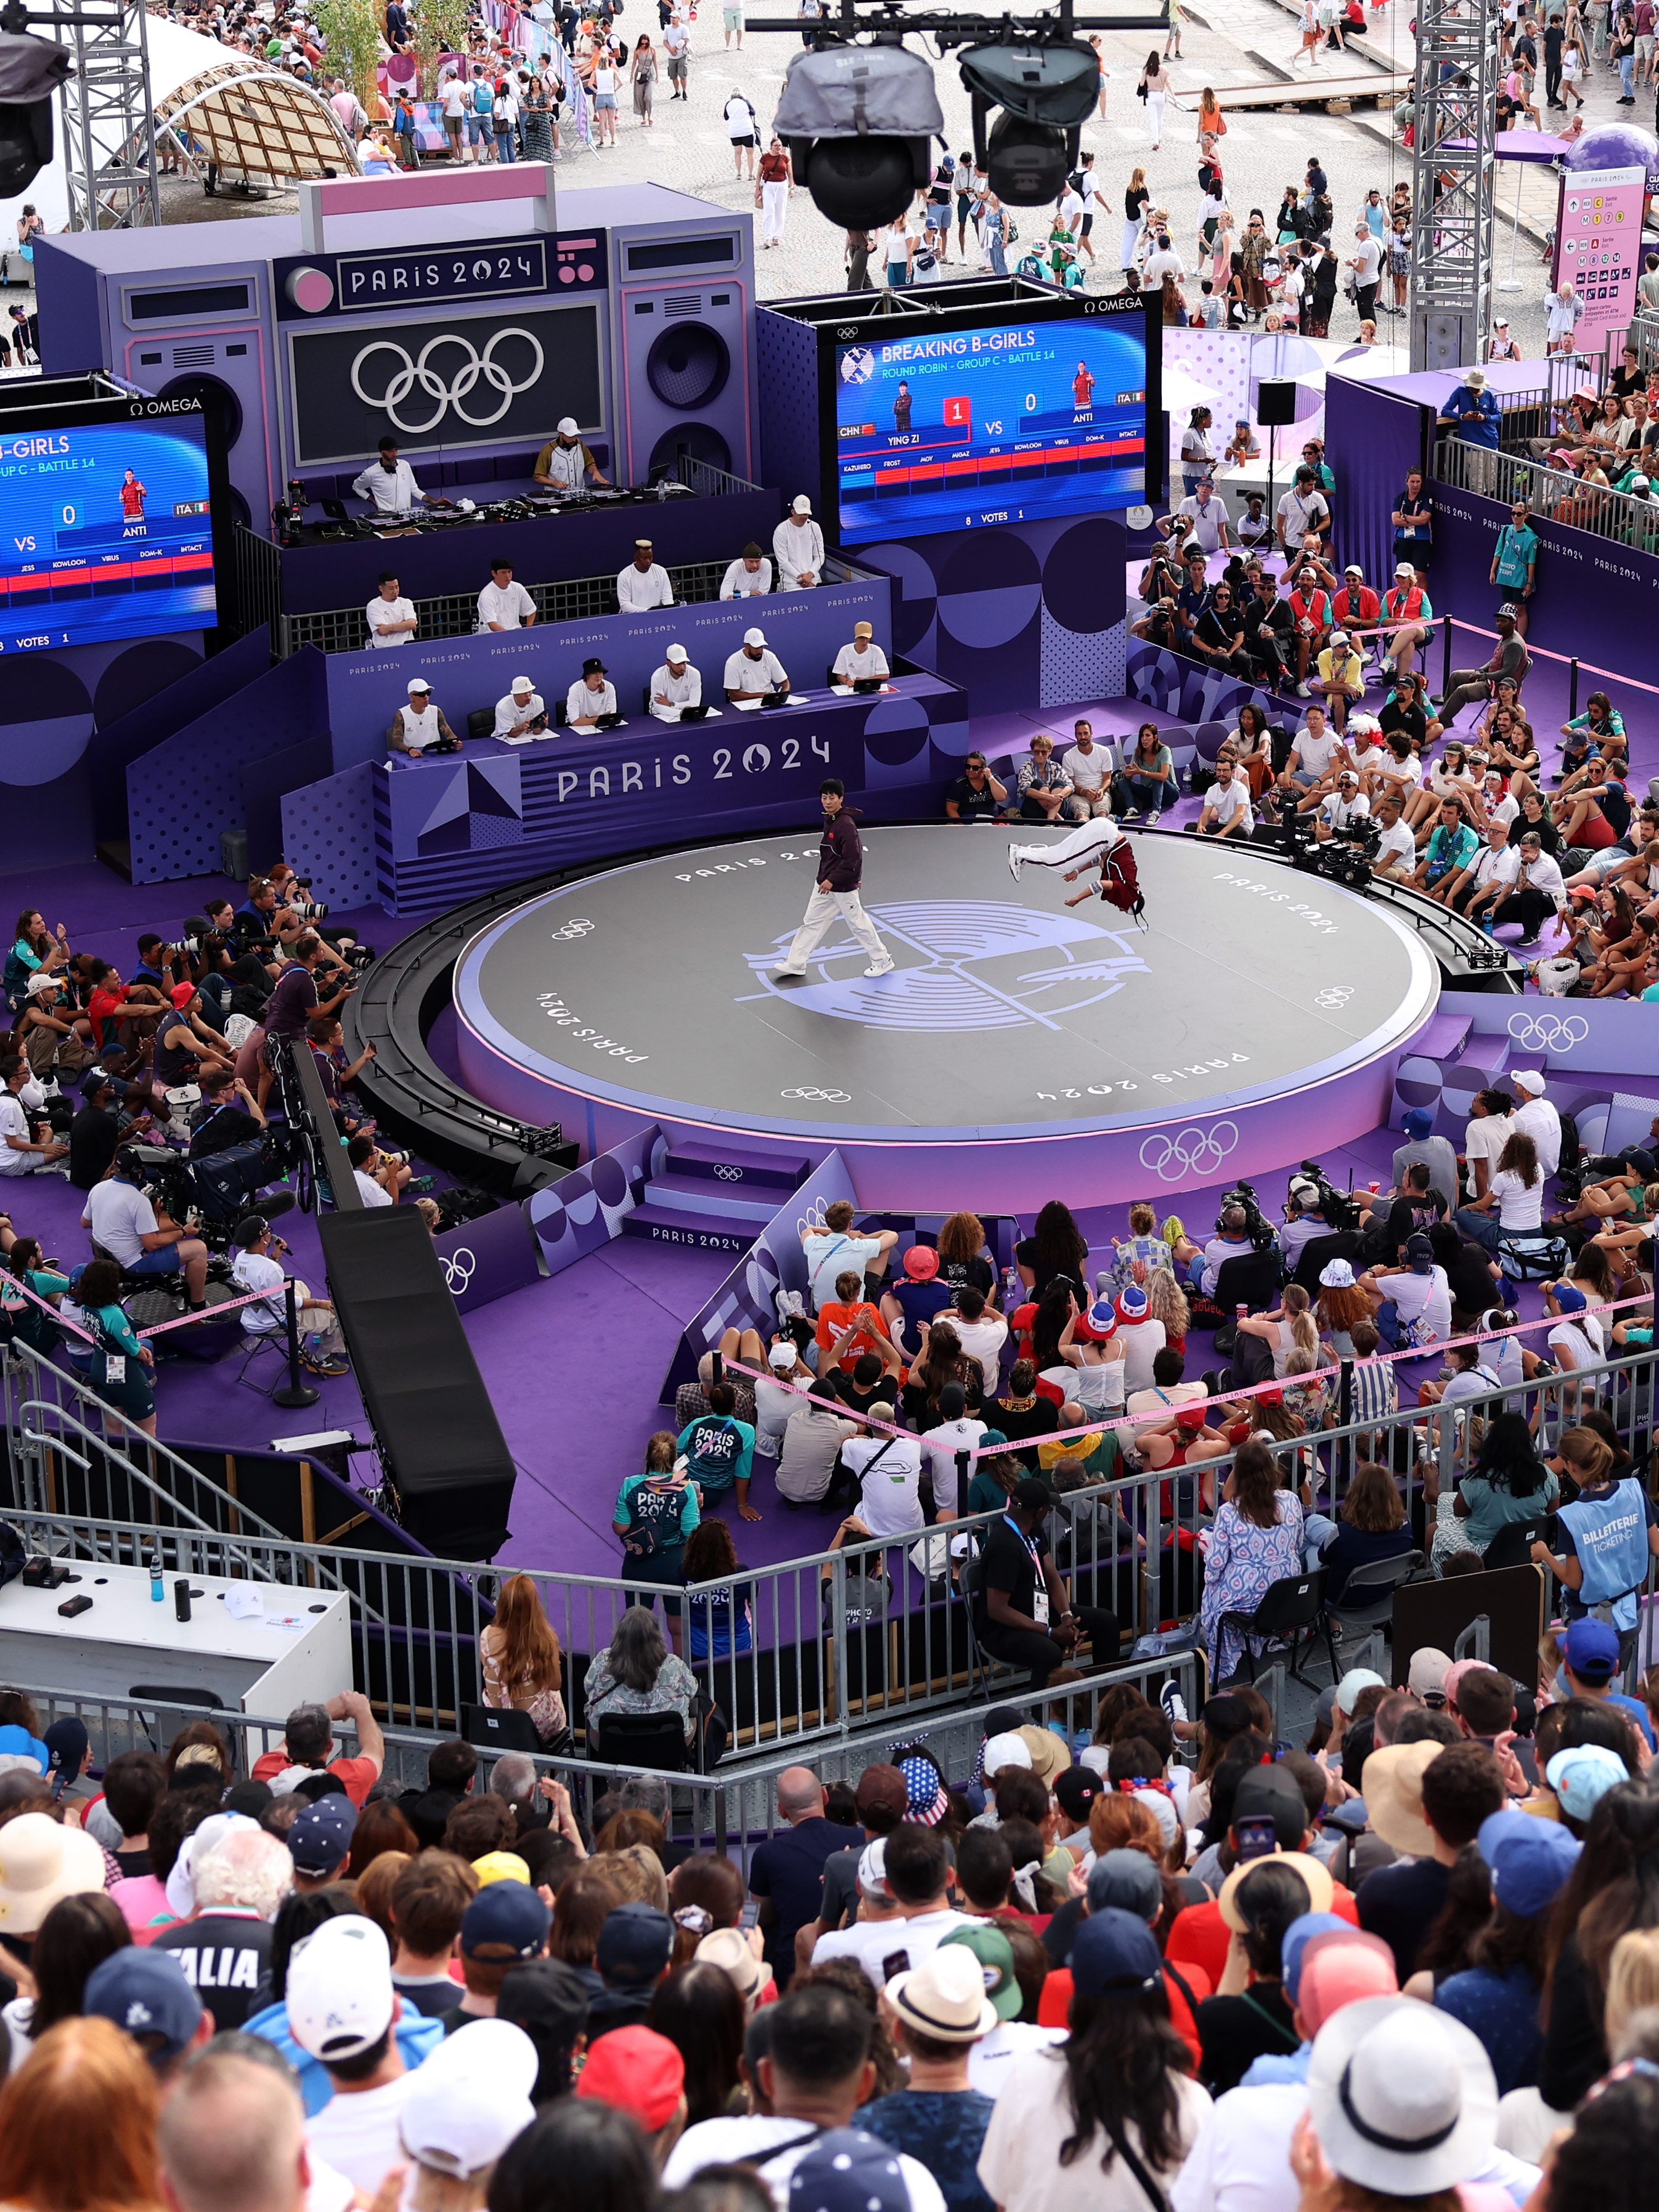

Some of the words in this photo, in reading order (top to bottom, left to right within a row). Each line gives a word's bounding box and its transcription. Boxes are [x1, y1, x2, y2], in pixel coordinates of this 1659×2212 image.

[351, 264, 440, 293] PARIS
[453, 255, 532, 283] 2024
[1098, 296, 1143, 311] OMEGA
[882, 338, 967, 363] BREAKING
[971, 330, 1035, 352] B-GIRLS
[882, 368, 916, 378] ROUND
[918, 362, 948, 375] ROBIN
[956, 357, 991, 370] GROUP
[992, 356, 1000, 365] C
[1009, 351, 1041, 364] BATTLE
[1043, 350, 1055, 360] 14
[147, 397, 202, 414] OMEGA
[1025, 393, 1037, 411] 0
[1117, 394, 1131, 404] ITA
[952, 402, 963, 420] 1
[1073, 413, 1093, 424] ANTI
[840, 426, 860, 437] CHN
[985, 420, 1003, 435] VS
[887, 435, 910, 446] YING
[911, 434, 919, 444] ZI
[844, 463, 871, 473] KAZUHIRO
[883, 460, 901, 468] FROST
[952, 450, 970, 458] MIGAZ
[1014, 442, 1042, 450] KOWLOON
[1119, 430, 1137, 438] INTACT
[18, 465, 28, 476] C
[38, 459, 79, 473] BATTLE
[81, 457, 96, 468] 14
[62, 505, 76, 525] 0
[176, 505, 192, 514] ITA
[965, 516, 971, 526] 8
[981, 511, 1008, 523] VOTES
[1018, 509, 1024, 518] 1
[1435, 502, 1451, 514] ARIS
[1453, 508, 1472, 521] 2024
[123, 526, 147, 538] ANTI
[14, 535, 37, 552] VS
[1538, 538, 1560, 553] PARIS
[1562, 547, 1583, 561] 2024
[20, 564, 35, 572] JESS
[52, 558, 86, 569] KOWLOON
[140, 549, 163, 558] DOM-K
[181, 544, 203, 553] INTACT
[1499, 561, 1516, 570] PHOTO
[1594, 558, 1617, 574] PARIS
[1620, 567, 1641, 582] 2024
[828, 598, 850, 607] PARIS
[853, 595, 873, 604] 2024
[762, 608, 785, 617] PARIS
[788, 604, 809, 613] 2024
[696, 617, 719, 626] PARIS
[722, 614, 743, 623] 2024
[629, 627, 652, 636] PARIS
[654, 624, 677, 633] 2024
[16, 635, 50, 648] VOTES
[62, 633, 69, 643] 1
[560, 637, 584, 646] PARIS
[587, 633, 609, 642] 2024
[491, 646, 515, 656] PARIS
[518, 643, 540, 652] 2024
[421, 656, 445, 665] PARIS
[448, 653, 470, 661] 2024
[349, 666, 374, 675] PARIS
[377, 662, 400, 672] 2024
[558, 754, 691, 802] PARIS
[712, 735, 830, 780] 2024
[674, 858, 767, 882] PARIS
[1213, 872, 1290, 901] PARIS
[1287, 904, 1339, 933] 2024
[536, 993, 582, 1025] 2024
[573, 1028, 650, 1063] PARIS
[1151, 1052, 1251, 1083] PARIS
[1037, 1080, 1138, 1101] 2024
[653, 1227, 694, 1244] PARIS
[700, 1235, 740, 1250] 2024
[230, 1298, 246, 1307] PARIS
[248, 1293, 264, 1301] 2024
[1573, 1309, 1590, 1318] PARIS
[1591, 1306, 1607, 1314] 2024
[150, 1325, 165, 1334] 2024
[1474, 1333, 1491, 1341] PARIS
[1492, 1329, 1509, 1337] 2024
[1372, 1355, 1389, 1363] PARIS
[1391, 1352, 1408, 1360] 2024
[1316, 1368, 1334, 1376] PARIS
[780, 1382, 795, 1393] PARIS
[796, 1388, 809, 1399] 2024
[1210, 1395, 1229, 1404] PARIS
[1230, 1391, 1247, 1399] 2024
[866, 1417, 882, 1428] PARIS
[882, 1422, 897, 1433] 2024
[1102, 1420, 1120, 1429] PARIS
[1122, 1416, 1139, 1425] 2024
[696, 1427, 735, 1447] PARIS
[695, 1439, 731, 1458] 2024
[990, 1444, 1009, 1453] PARIS
[1012, 1441, 1029, 1449] 2024
[1583, 1513, 1639, 1545] BILLETTERIE
[1593, 1529, 1633, 1553] TICKETING
[166, 1947, 259, 1988] ALIA
